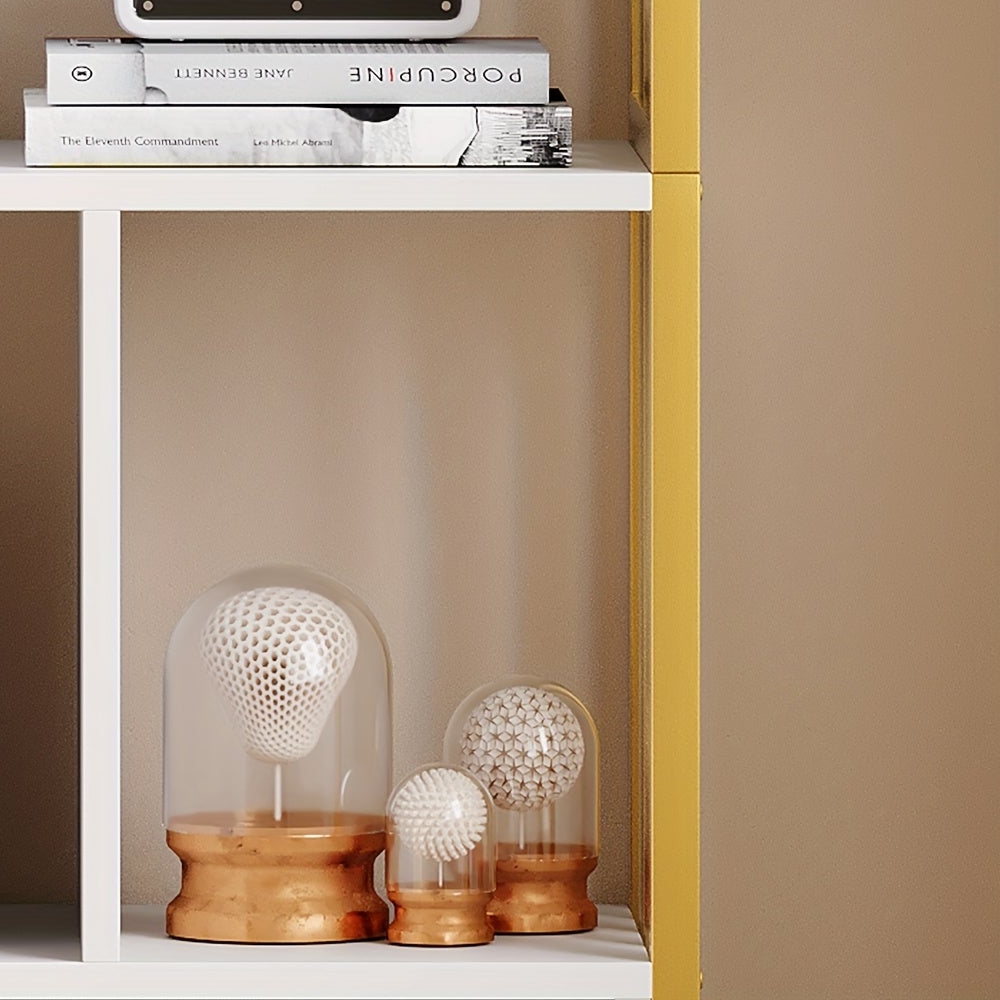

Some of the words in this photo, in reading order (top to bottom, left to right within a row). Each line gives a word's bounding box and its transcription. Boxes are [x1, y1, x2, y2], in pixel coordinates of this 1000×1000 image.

[174, 67, 249, 79] BENNETT
[253, 67, 294, 79] JANE
[348, 65, 523, 84] PORCUPINE
[60, 135, 81, 147] The
[84, 135, 132, 147] Eleventh
[134, 135, 220, 147] Commandment
